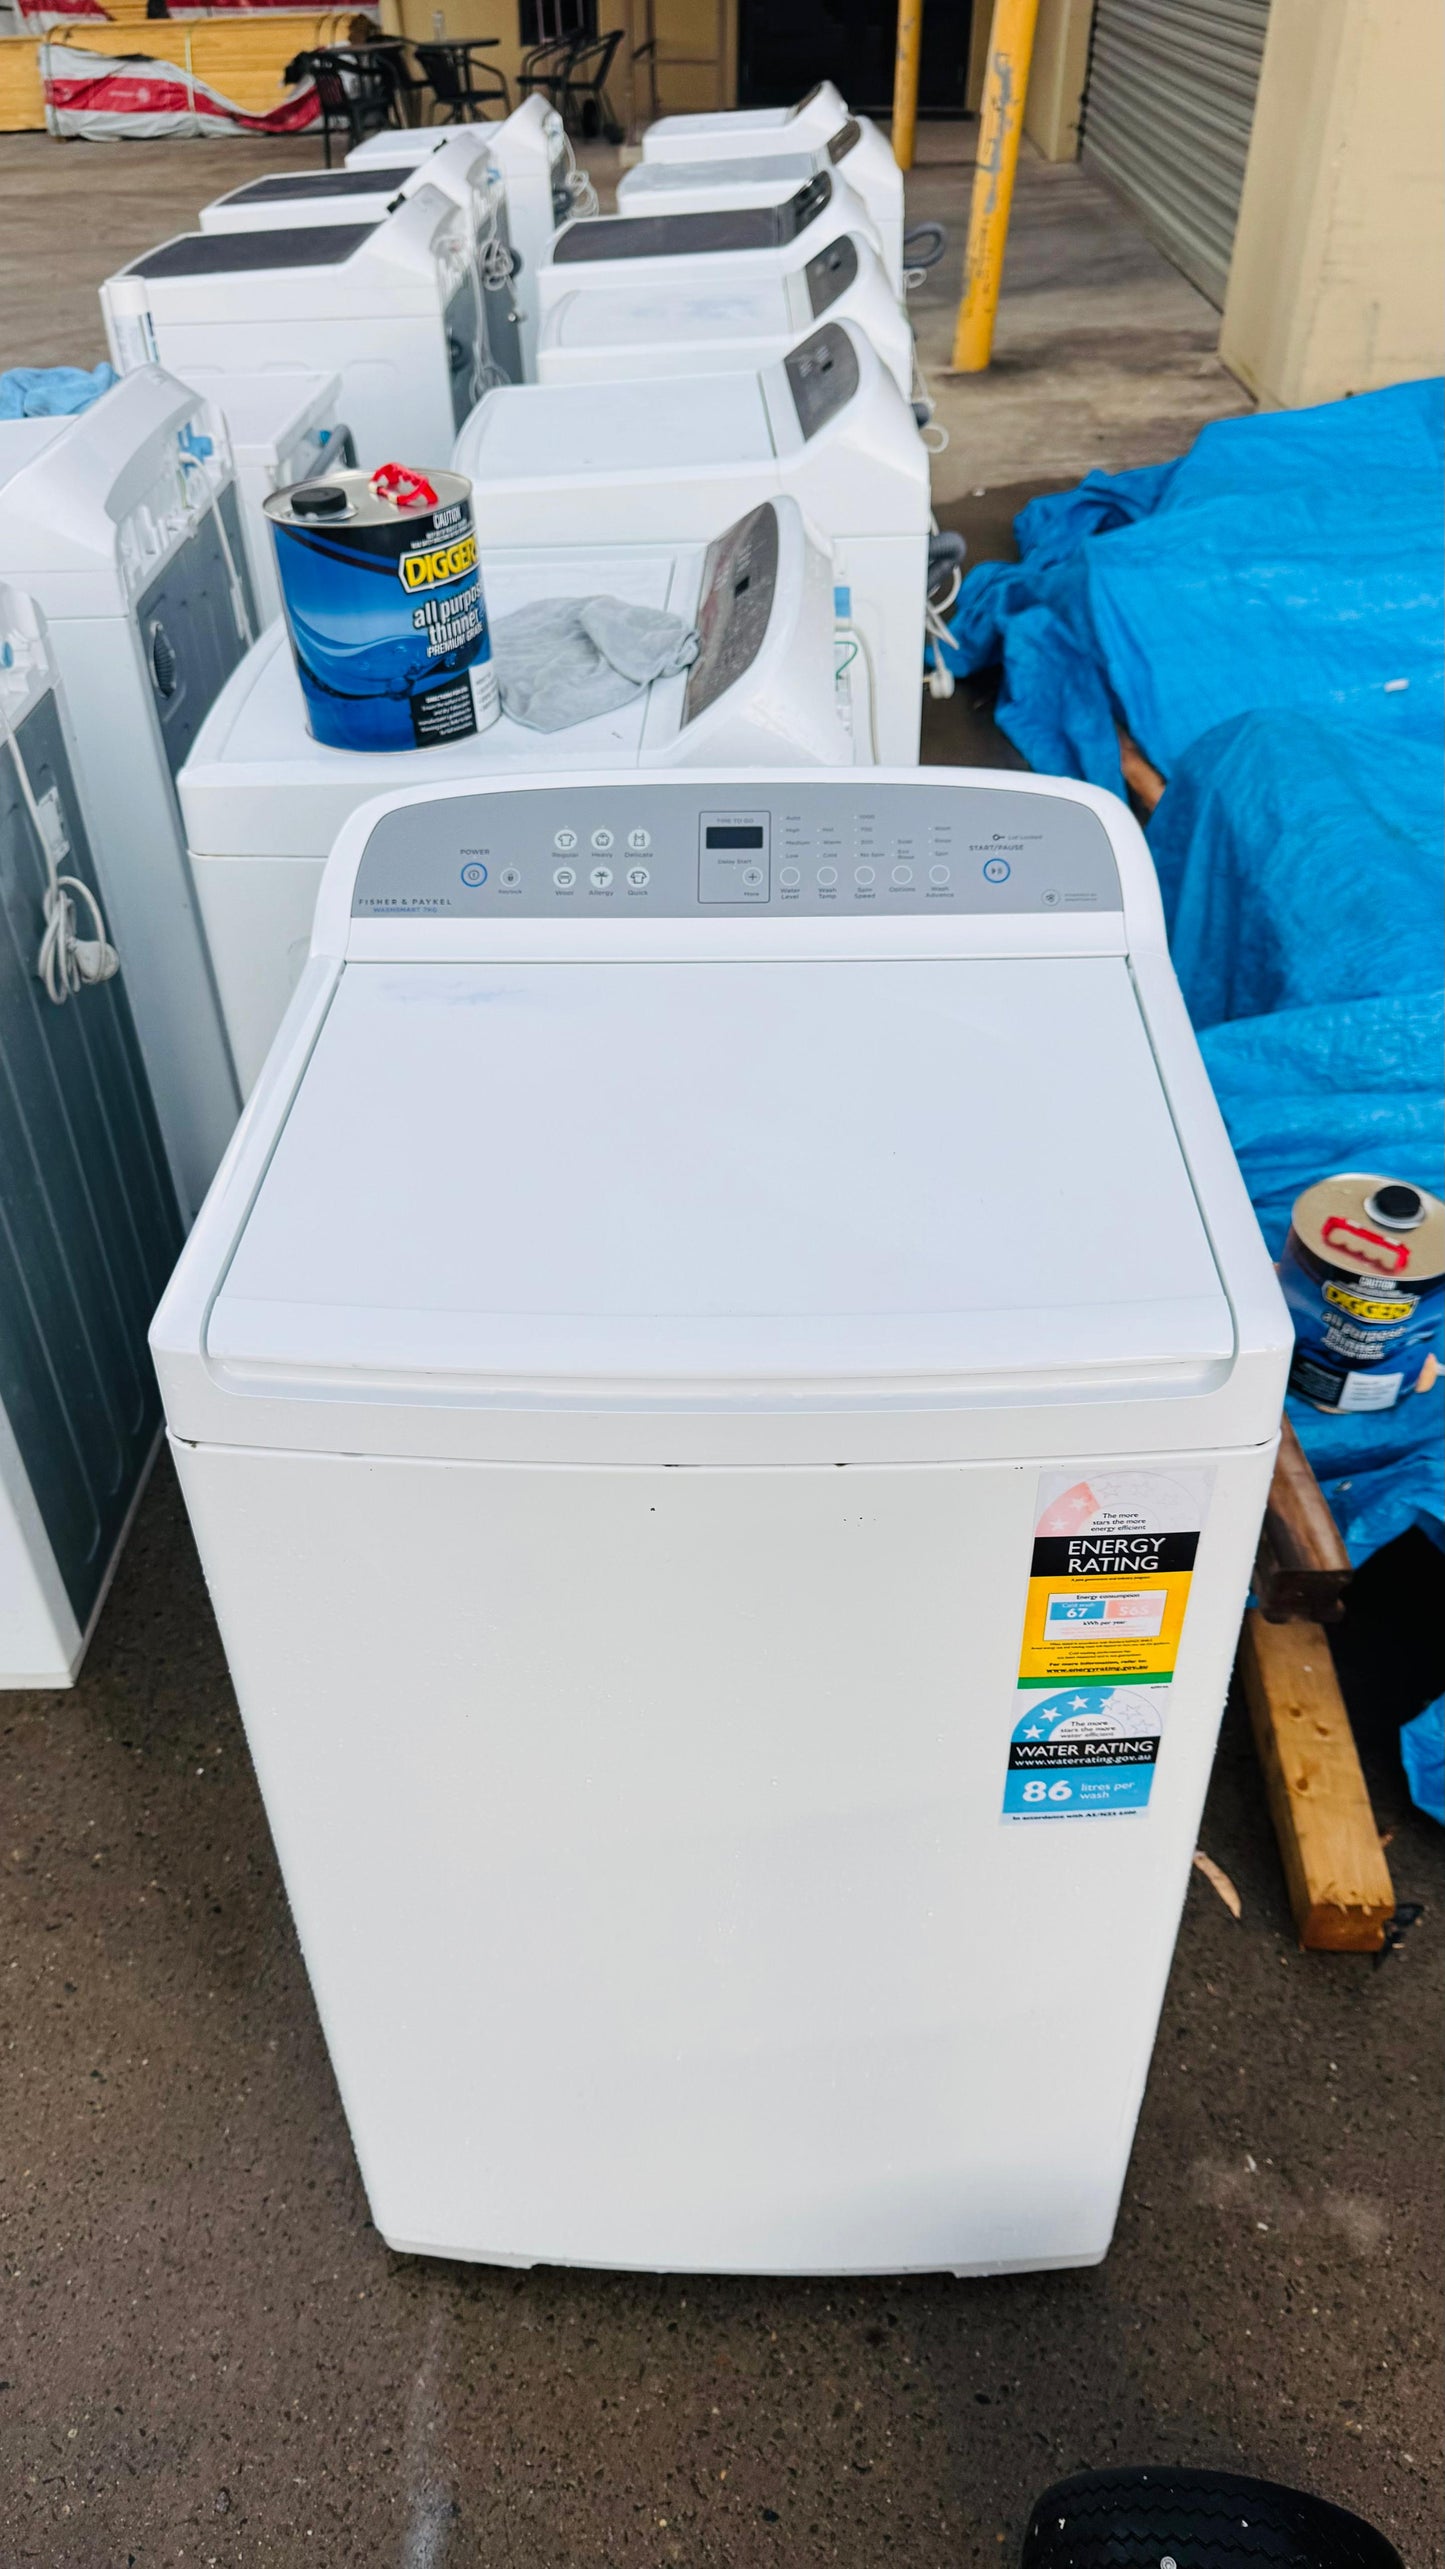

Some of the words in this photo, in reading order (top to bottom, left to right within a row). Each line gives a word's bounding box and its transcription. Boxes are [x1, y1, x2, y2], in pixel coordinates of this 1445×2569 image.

[432, 506, 462, 530] CAUTION
[405, 533, 478, 588] DIGGER
[413, 600, 438, 628] all
[440, 583, 481, 624] purpos
[429, 609, 479, 645] thinner
[426, 634, 466, 658] PREMIUM
[459, 848, 490, 856] POWER
[358, 898, 398, 906] FISHER
[411, 898, 452, 906] PAYKEL
[1068, 1537, 1167, 1556] ENERGY
[1067, 1556, 1160, 1573] RATING
[1066, 1607, 1088, 1619] 67
[1046, 1664, 1149, 1674] www.energyrating.gov.au
[1016, 1744, 1079, 1758] WATER
[1084, 1740, 1154, 1755] RATING
[1014, 1754, 1152, 1767] www.waterrating.gov.au
[1022, 1779, 1073, 1803] 86
[1081, 1783, 1111, 1792] litres
[1113, 1781, 1135, 1792] per
[1080, 1792, 1110, 1800] wash
